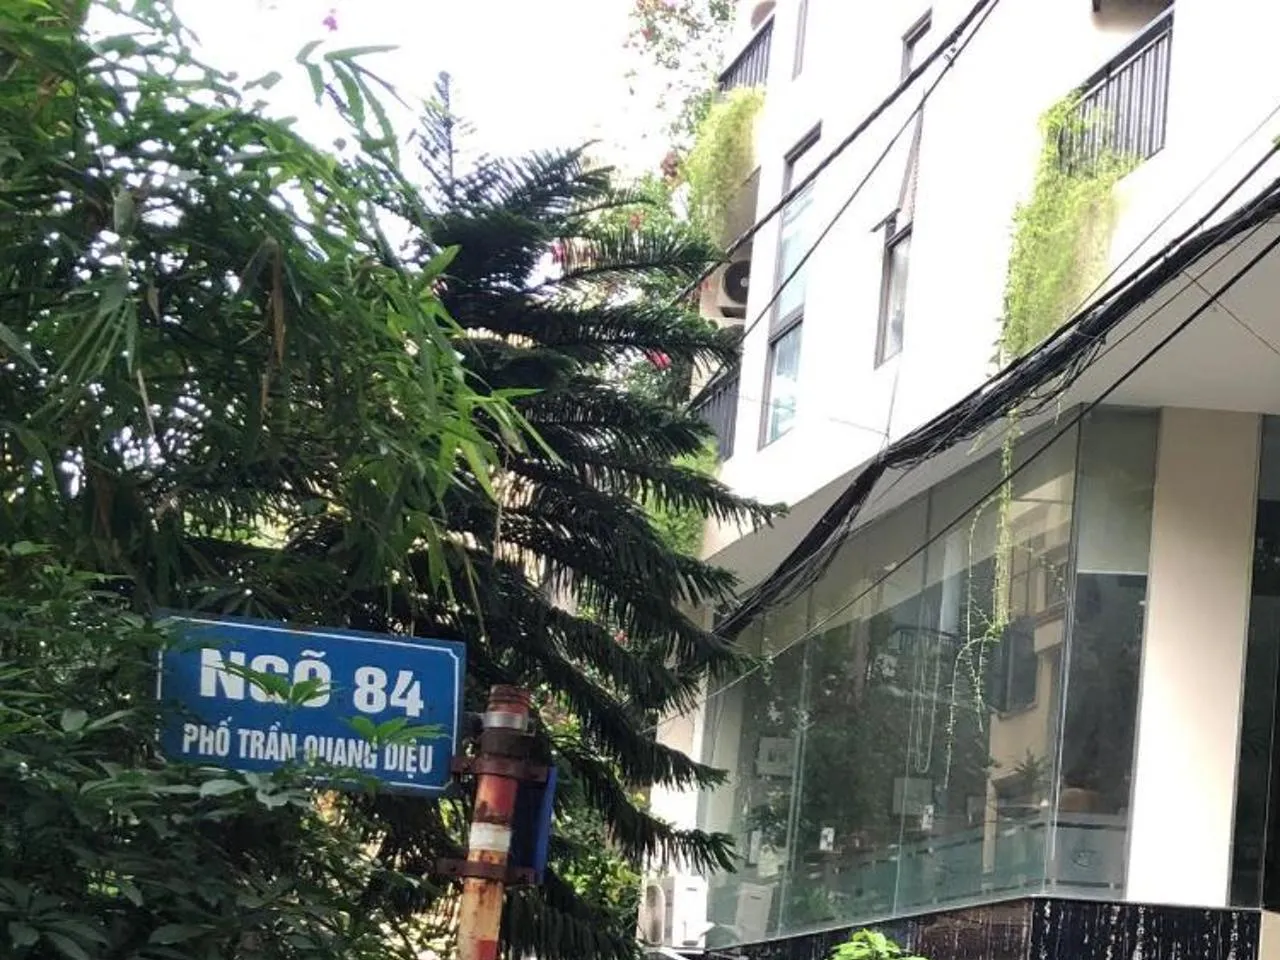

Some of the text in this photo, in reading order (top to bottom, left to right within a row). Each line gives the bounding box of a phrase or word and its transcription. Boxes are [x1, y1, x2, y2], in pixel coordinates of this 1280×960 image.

[353, 666, 425, 718] 84
[182, 716, 434, 779] PHỐ TRẦN QUANG DIỆU
